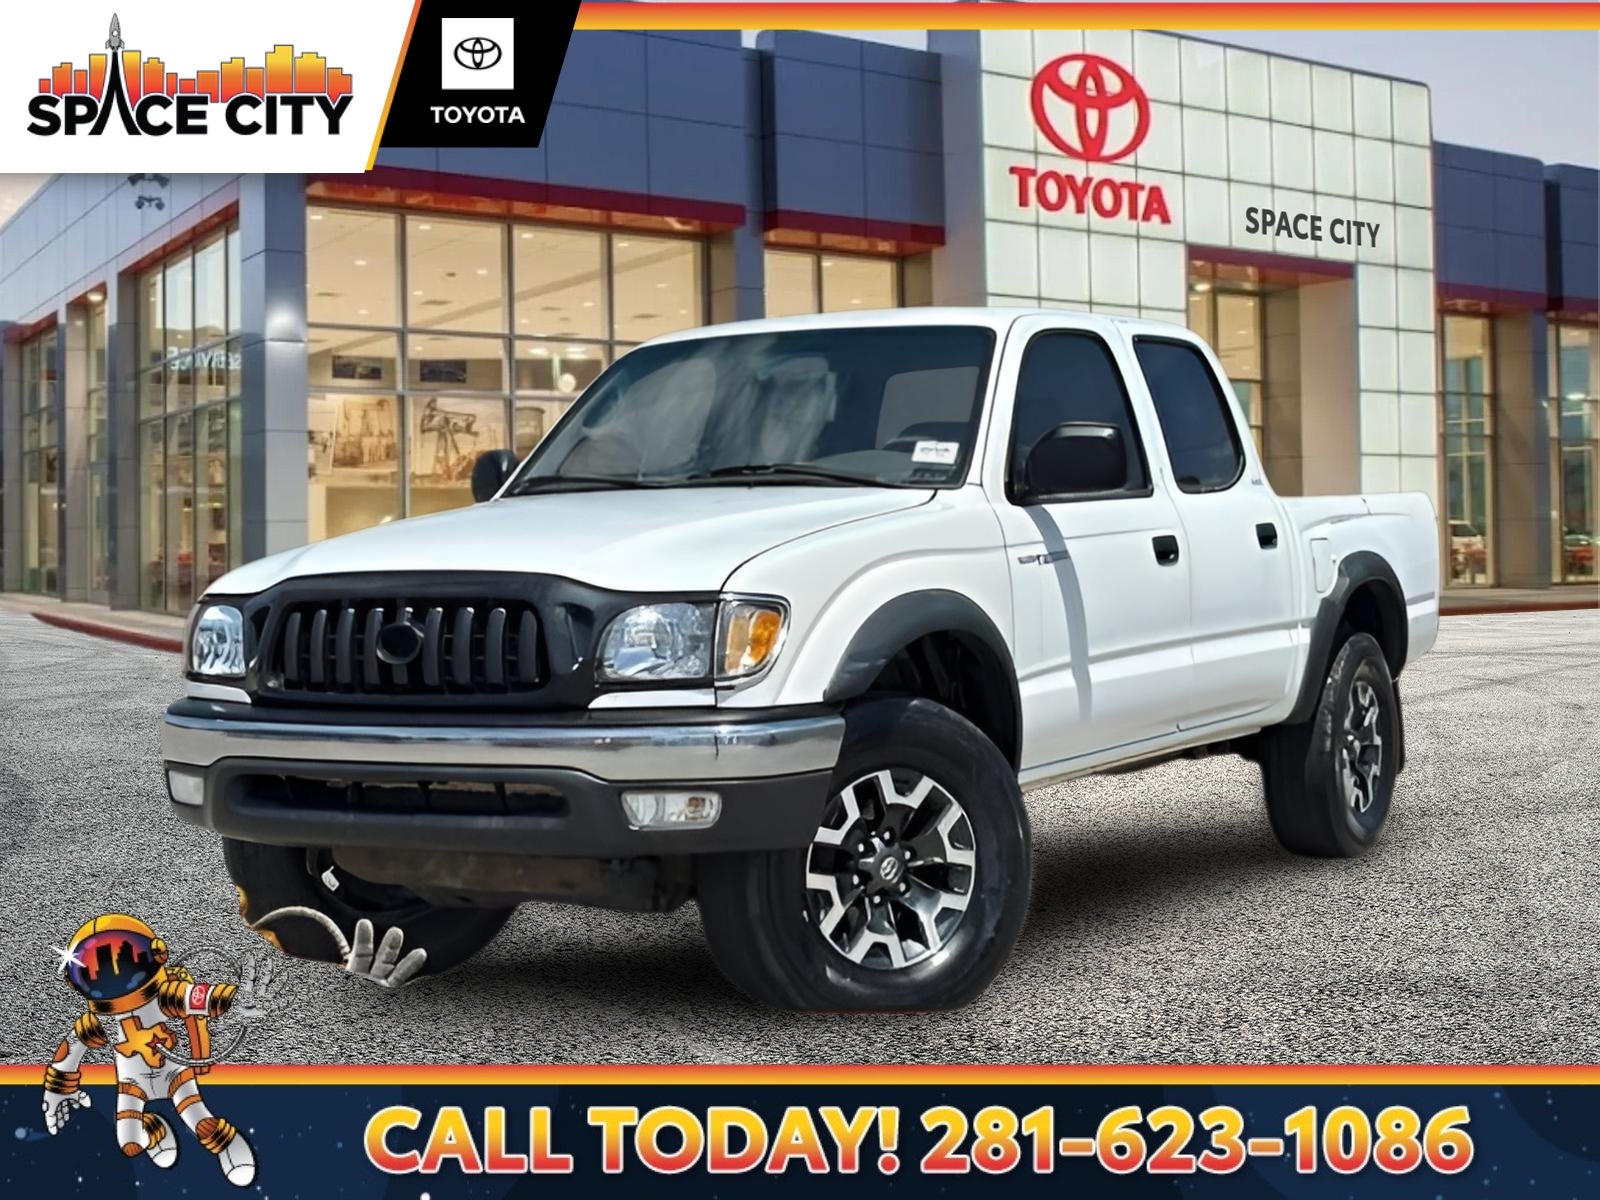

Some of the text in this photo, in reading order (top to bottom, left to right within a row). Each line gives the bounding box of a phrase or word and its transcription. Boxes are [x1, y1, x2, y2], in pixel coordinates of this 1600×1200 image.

[1009, 166, 1171, 225] TOYOTA
[1245, 206, 1380, 248] SPACE CITY
